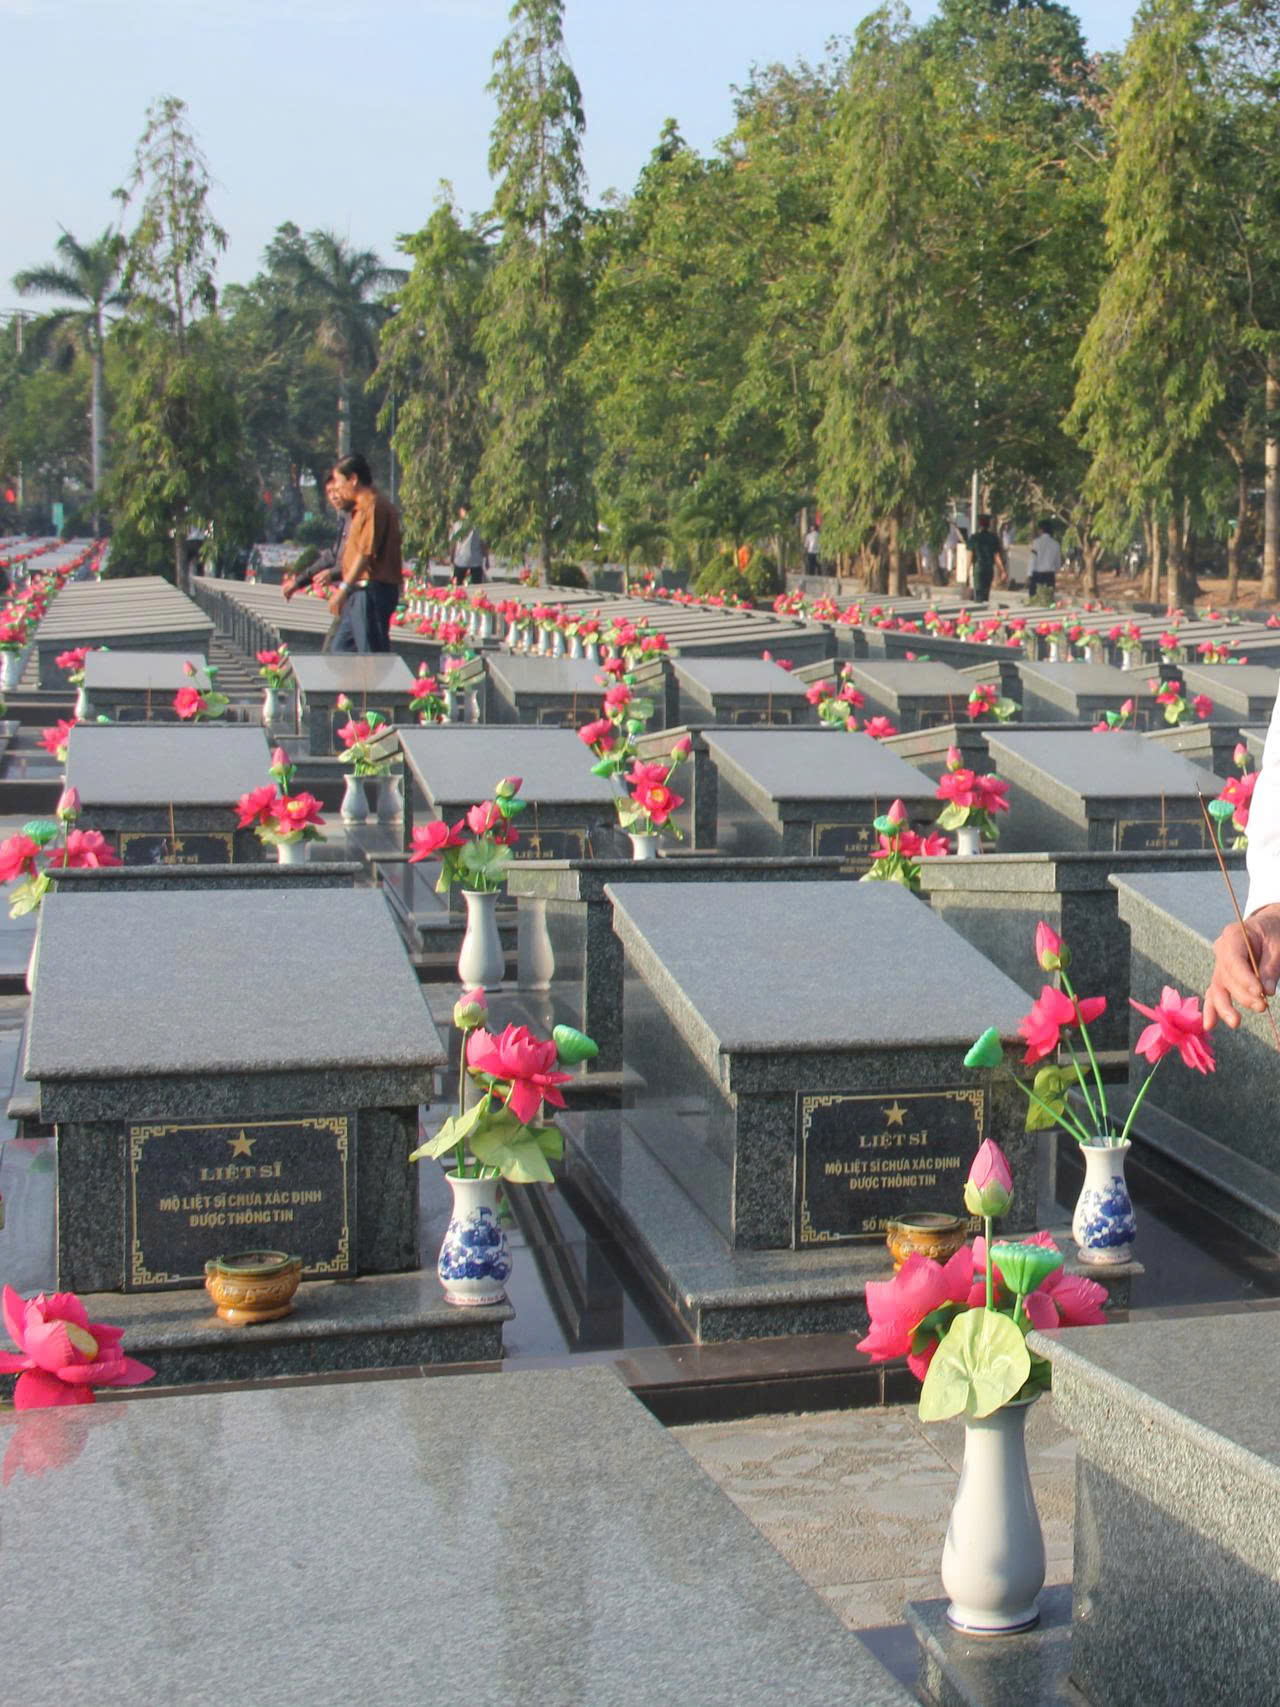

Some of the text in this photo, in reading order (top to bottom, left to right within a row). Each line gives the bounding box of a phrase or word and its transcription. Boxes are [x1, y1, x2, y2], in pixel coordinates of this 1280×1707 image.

[858, 1131, 929, 1150] LIỆT SĨ
[199, 1160, 283, 1182] LIỆT SĨ
[825, 1155, 961, 1177] MỘ LIỆT SĨ CHƯA XÁC ĐỊNH
[849, 1172, 937, 1191] ĐƯỢC THÔNG TIN
[159, 1189, 323, 1213] MỘ LIỆT SĨ CHƯA XÁC ĐỊNH
[189, 1208, 295, 1229] ĐƯỢC THÔNG TIN
[861, 1214, 877, 1232] SỐ
